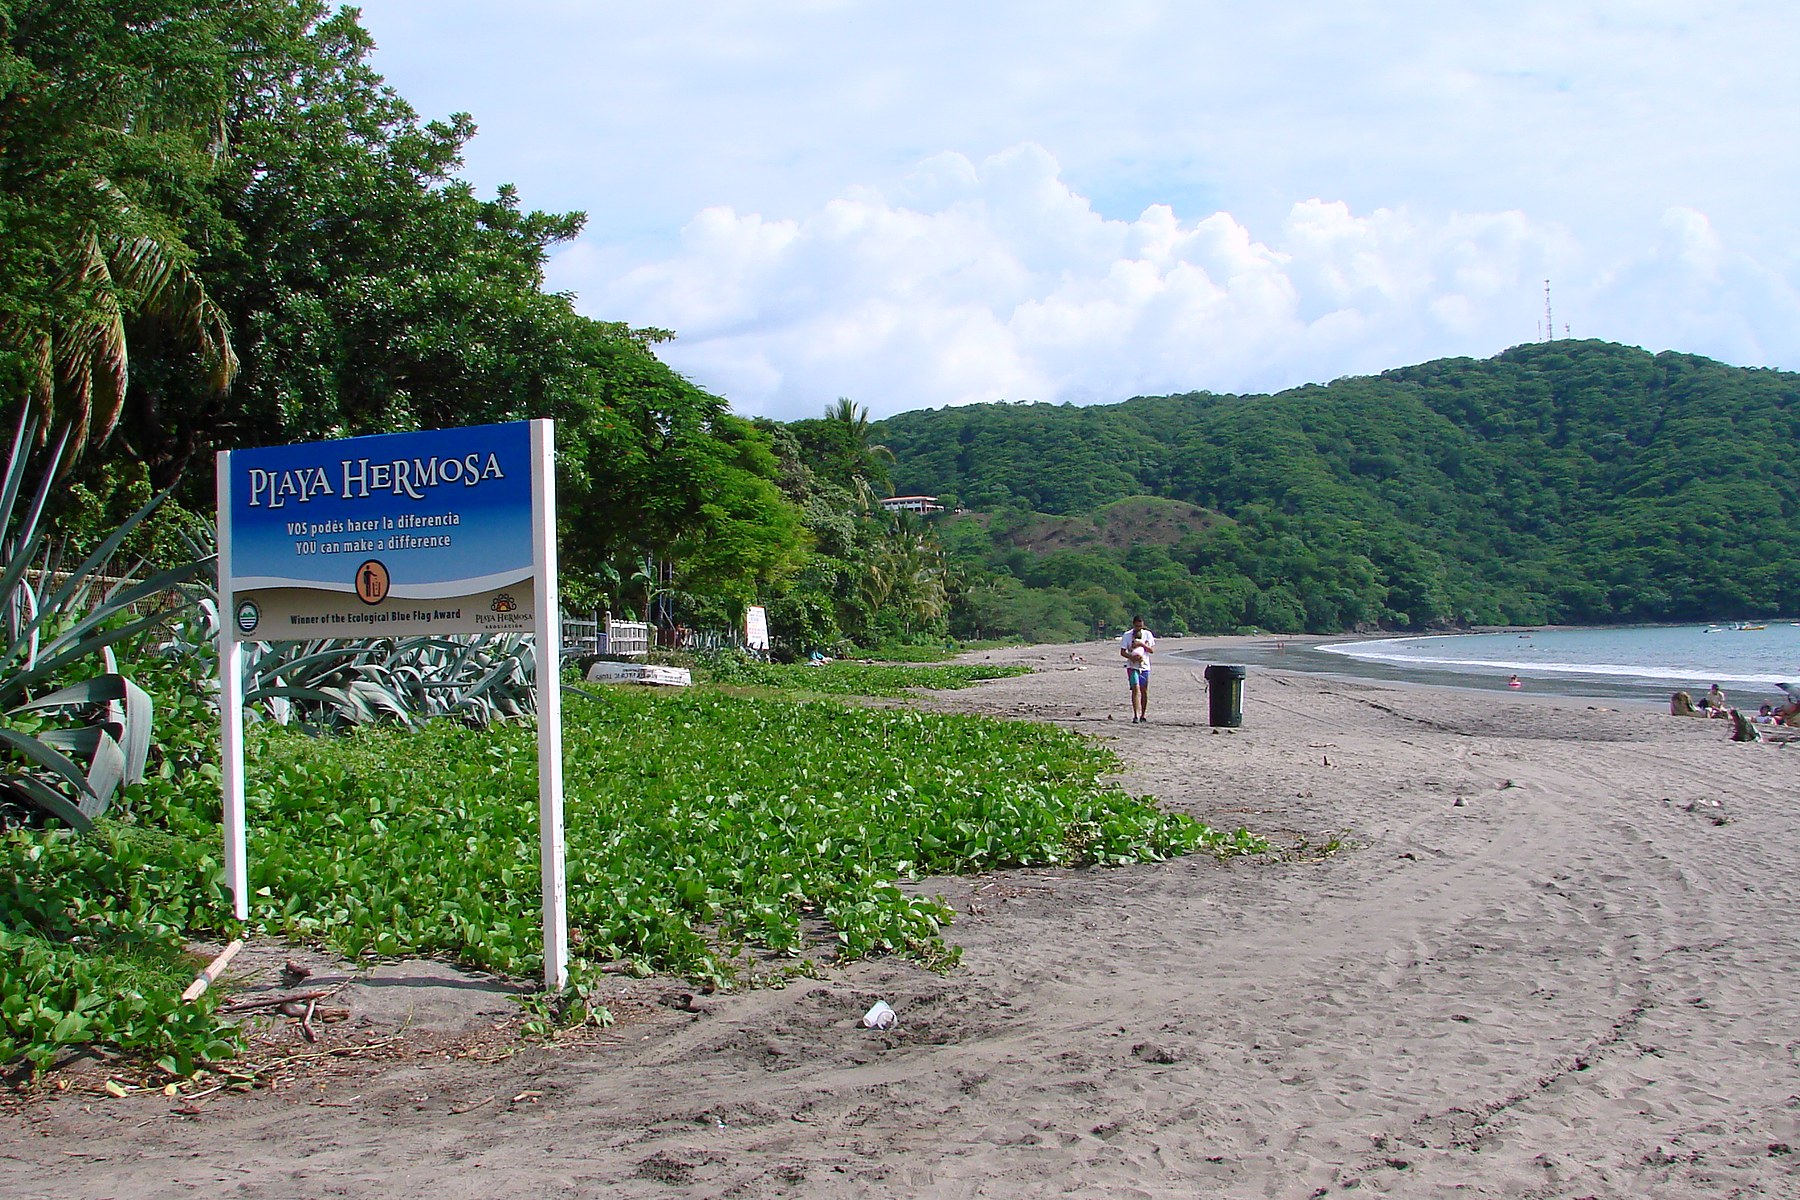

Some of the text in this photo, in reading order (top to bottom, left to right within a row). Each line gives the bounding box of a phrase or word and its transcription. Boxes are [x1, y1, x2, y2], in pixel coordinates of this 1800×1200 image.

[249, 453, 504, 508] PLAYA HERMOSA
[287, 522, 308, 536] VOS
[347, 518, 379, 532] hacer
[382, 516, 394, 530] la
[397, 511, 460, 529] diferencia
[296, 535, 451, 555] YOU can make a difference
[290, 609, 461, 625] Winner of the Ecological Blue Flag Award
[475, 613, 533, 624] PLAYA HERMOSA
